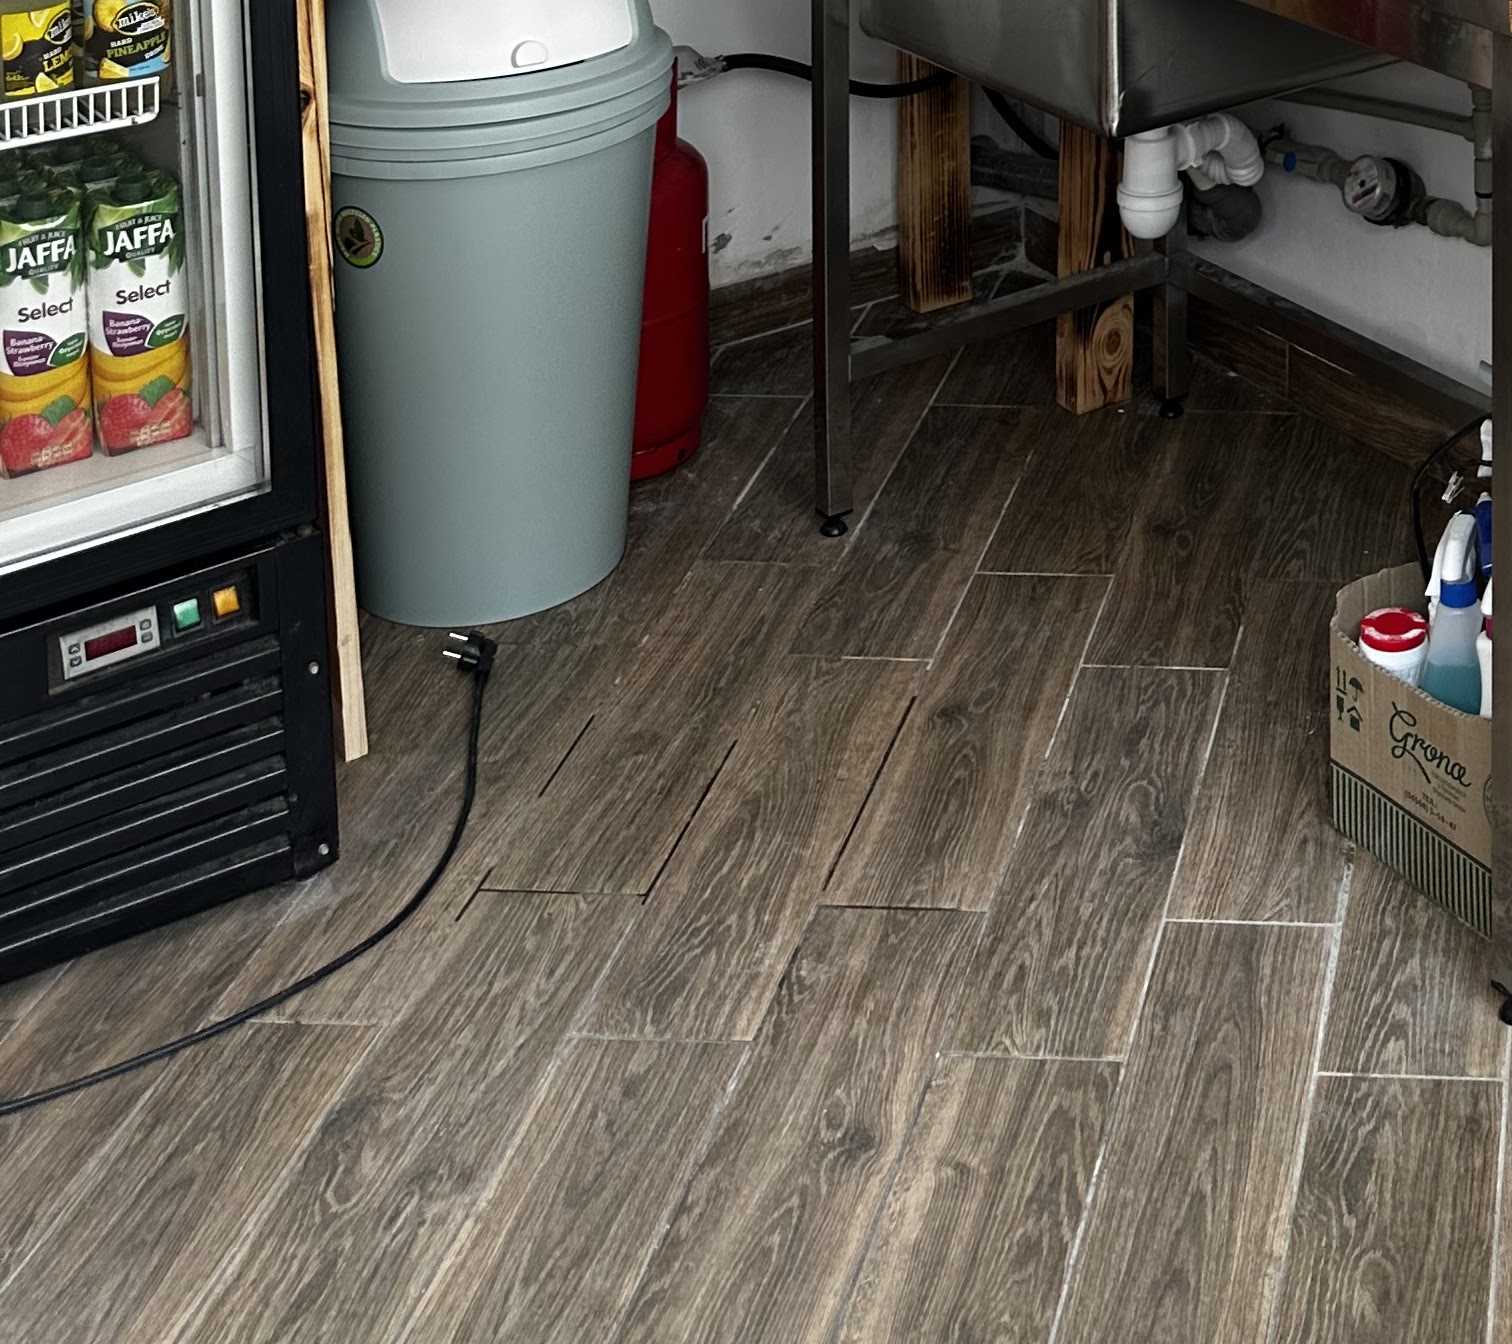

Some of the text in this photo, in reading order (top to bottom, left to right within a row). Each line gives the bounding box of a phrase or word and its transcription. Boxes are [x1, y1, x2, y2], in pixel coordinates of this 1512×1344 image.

[118, 7, 156, 28] mike's
[107, 31, 168, 59] PINEAPPLE
[110, 37, 133, 48] HARD
[103, 218, 176, 256] JAFFA
[6, 234, 76, 273] JAFFA
[115, 279, 171, 305] Select
[17, 297, 74, 323] Select
[1389, 701, 1472, 788] Grona
